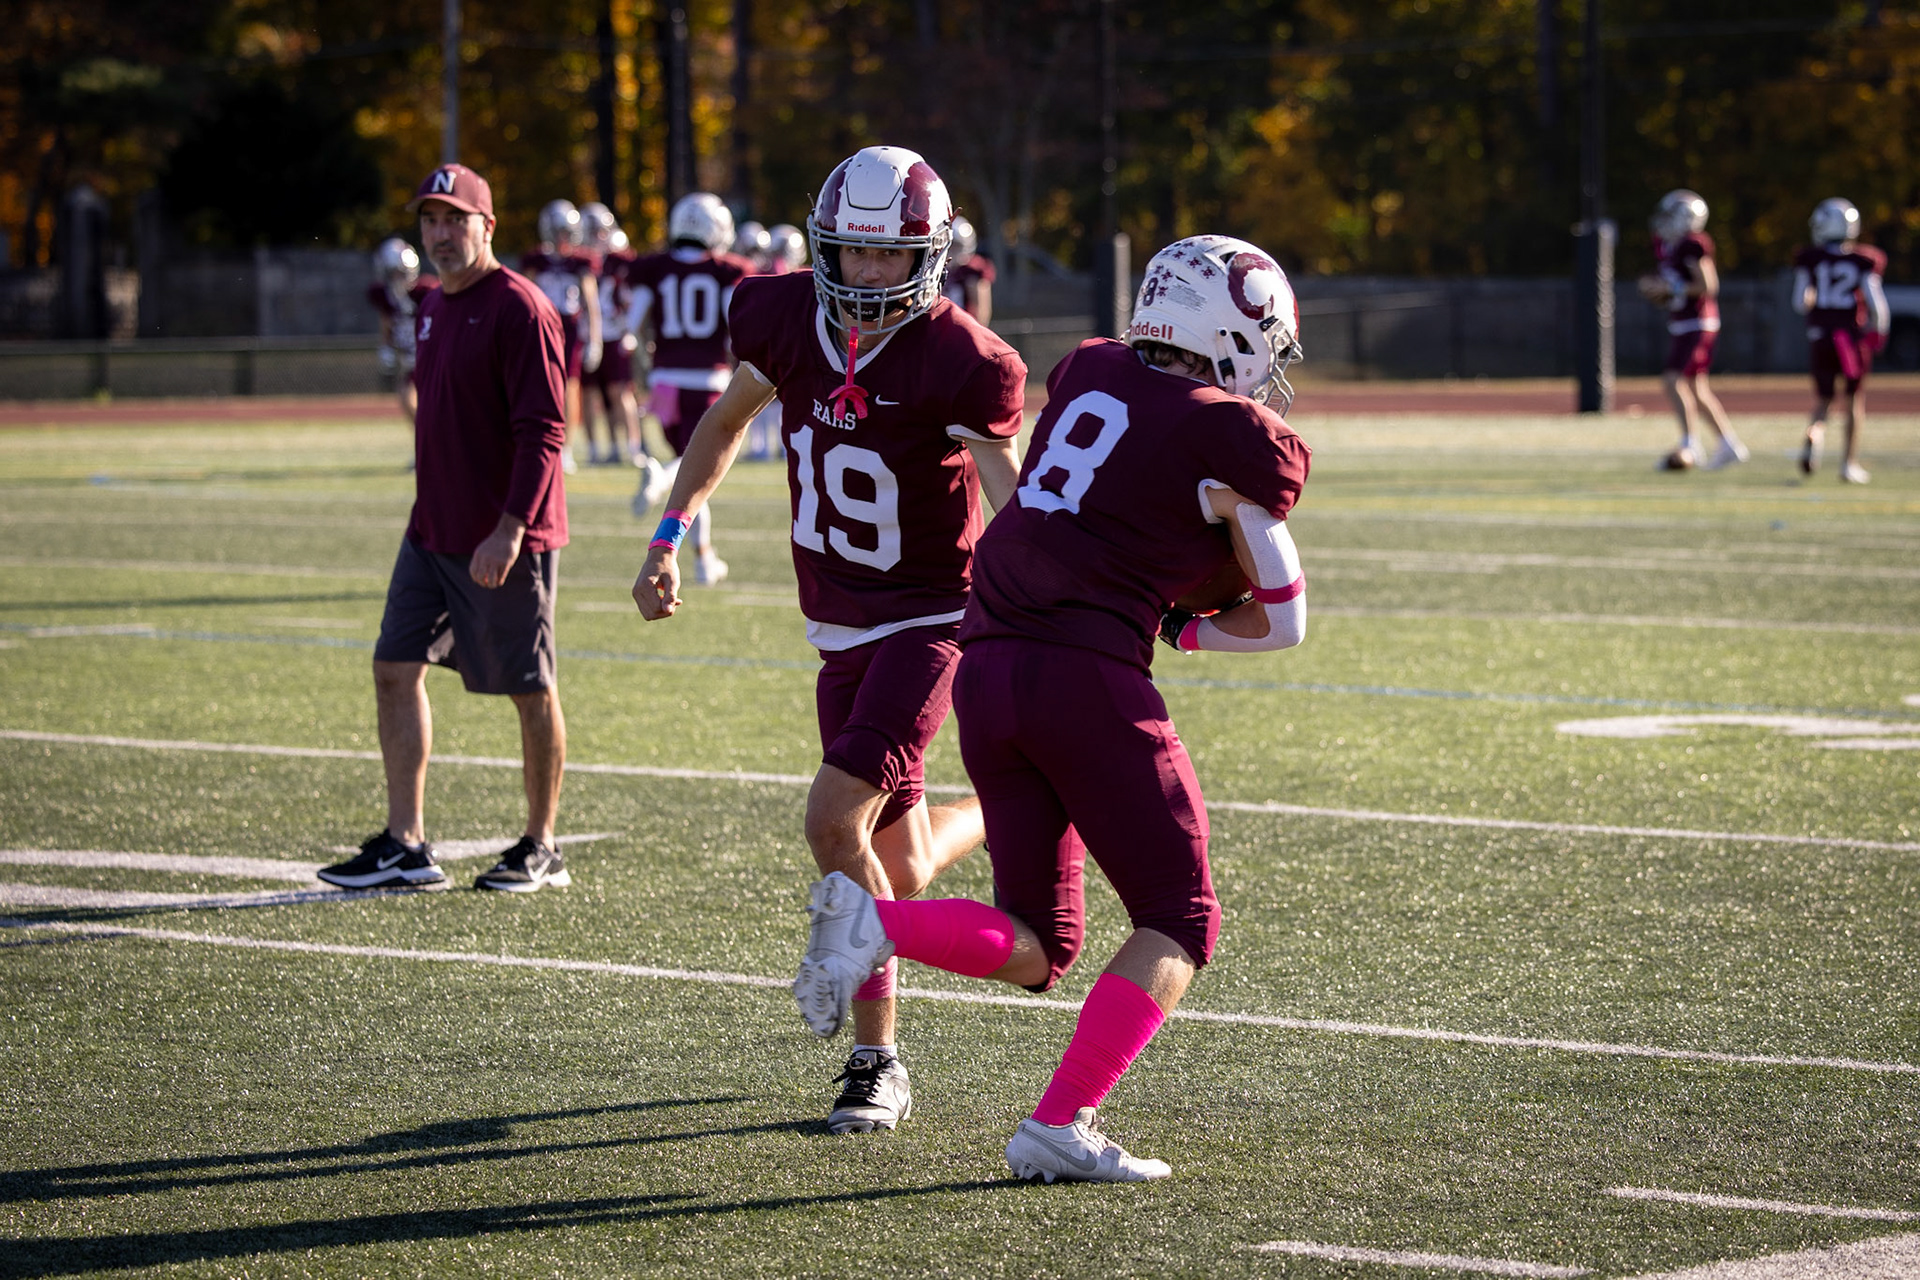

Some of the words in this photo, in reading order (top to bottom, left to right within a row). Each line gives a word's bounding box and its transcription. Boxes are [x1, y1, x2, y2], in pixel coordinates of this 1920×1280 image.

[432, 171, 457, 193] N
[847, 222, 885, 233] Riddell
[658, 272, 720, 340] 10
[1142, 276, 1159, 307] 8
[1815, 260, 1859, 310] 12
[1017, 390, 1130, 515] 8
[789, 424, 902, 573] 19
